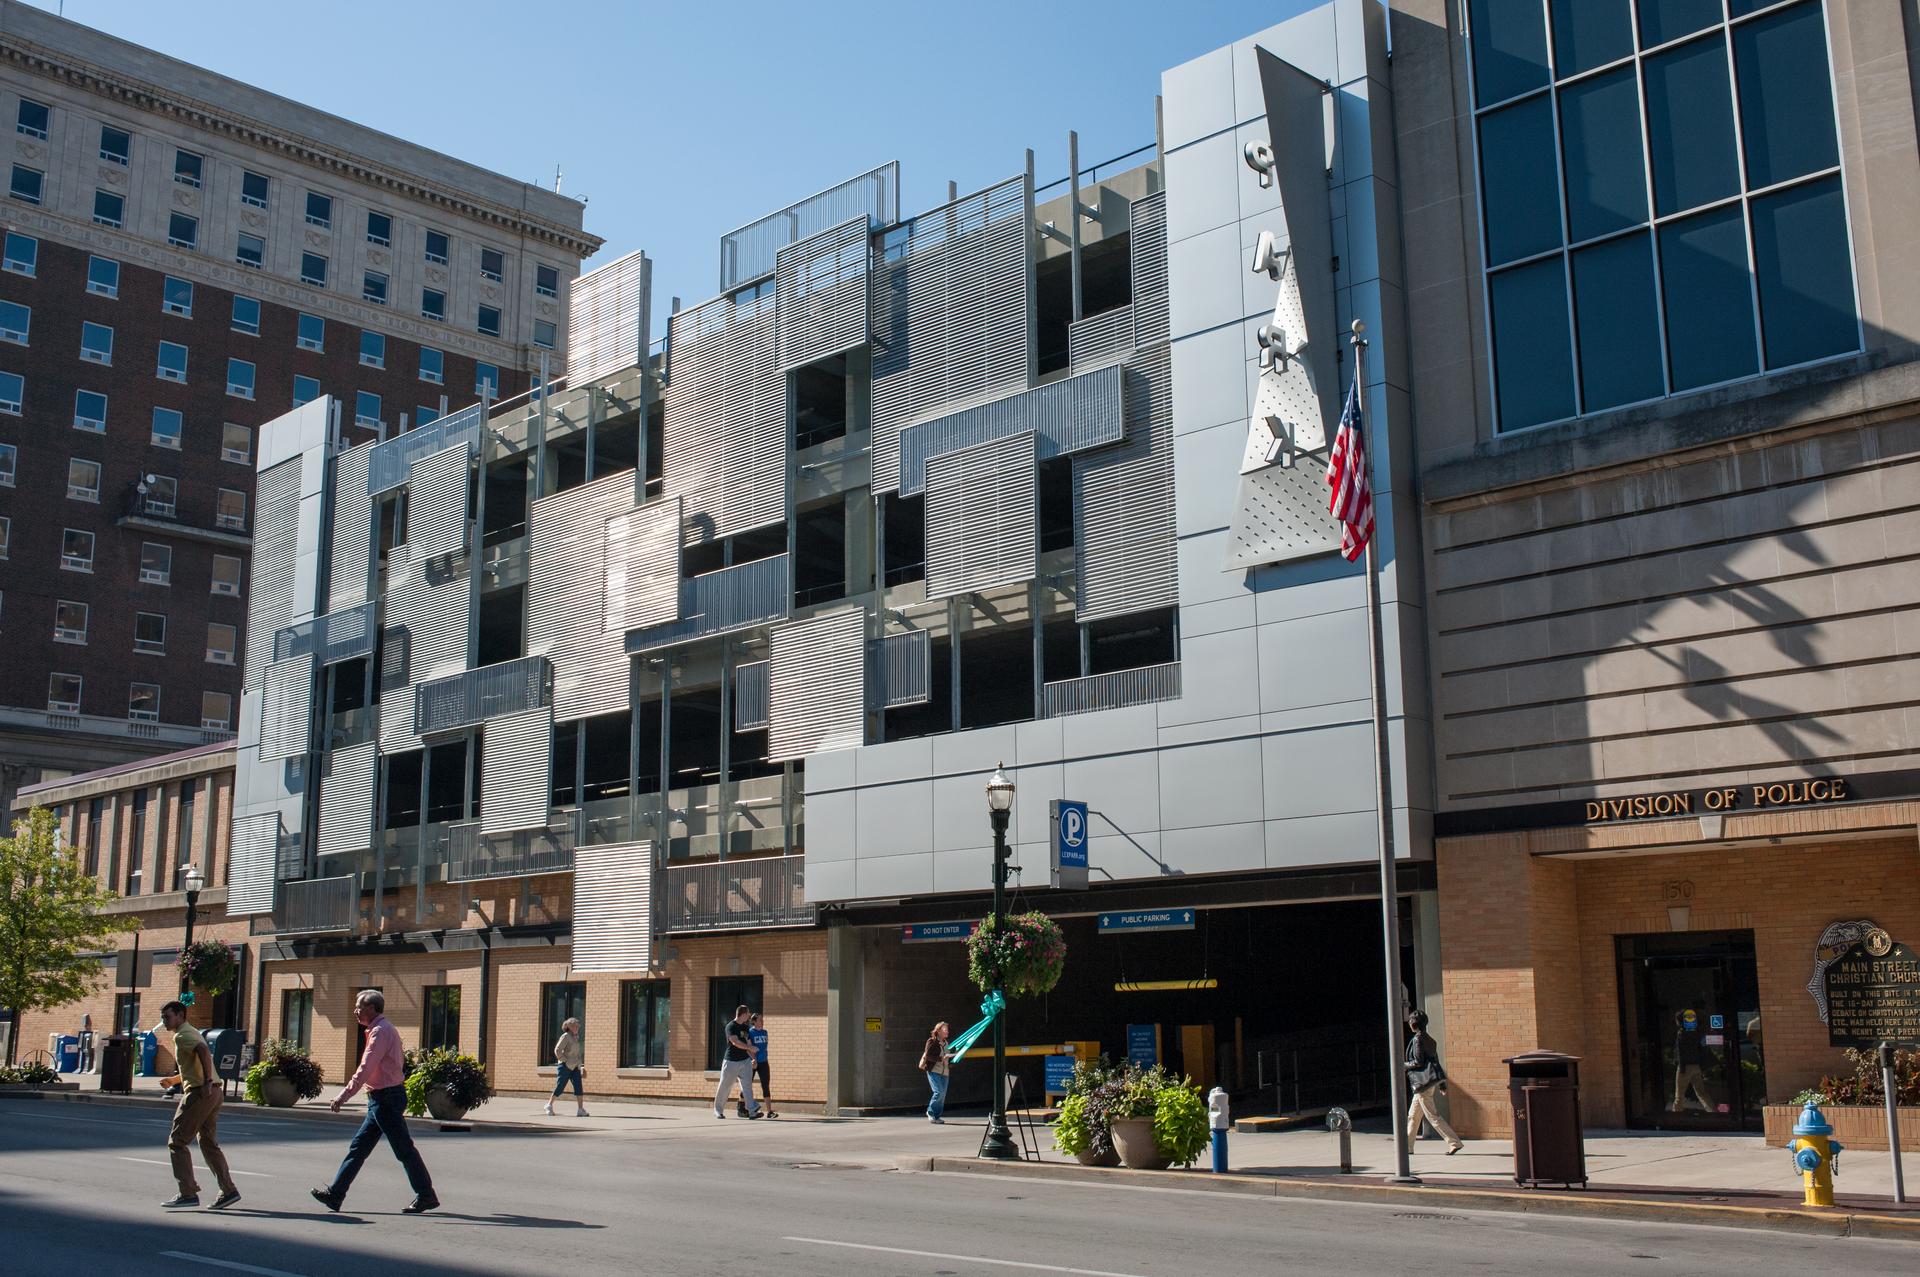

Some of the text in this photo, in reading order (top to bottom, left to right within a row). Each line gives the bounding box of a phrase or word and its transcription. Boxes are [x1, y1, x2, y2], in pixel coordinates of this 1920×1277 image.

[1586, 779, 1847, 820] DIVISION OF POLICE
[1143, 914, 1170, 922] PARKING
[1842, 961, 1918, 972] MAIN STREET
[1829, 972, 1920, 984] CHRISTIAN CHUR
[1868, 1008, 1904, 1016] CHRISTIAN
[1904, 1008, 1920, 1016] BAP
